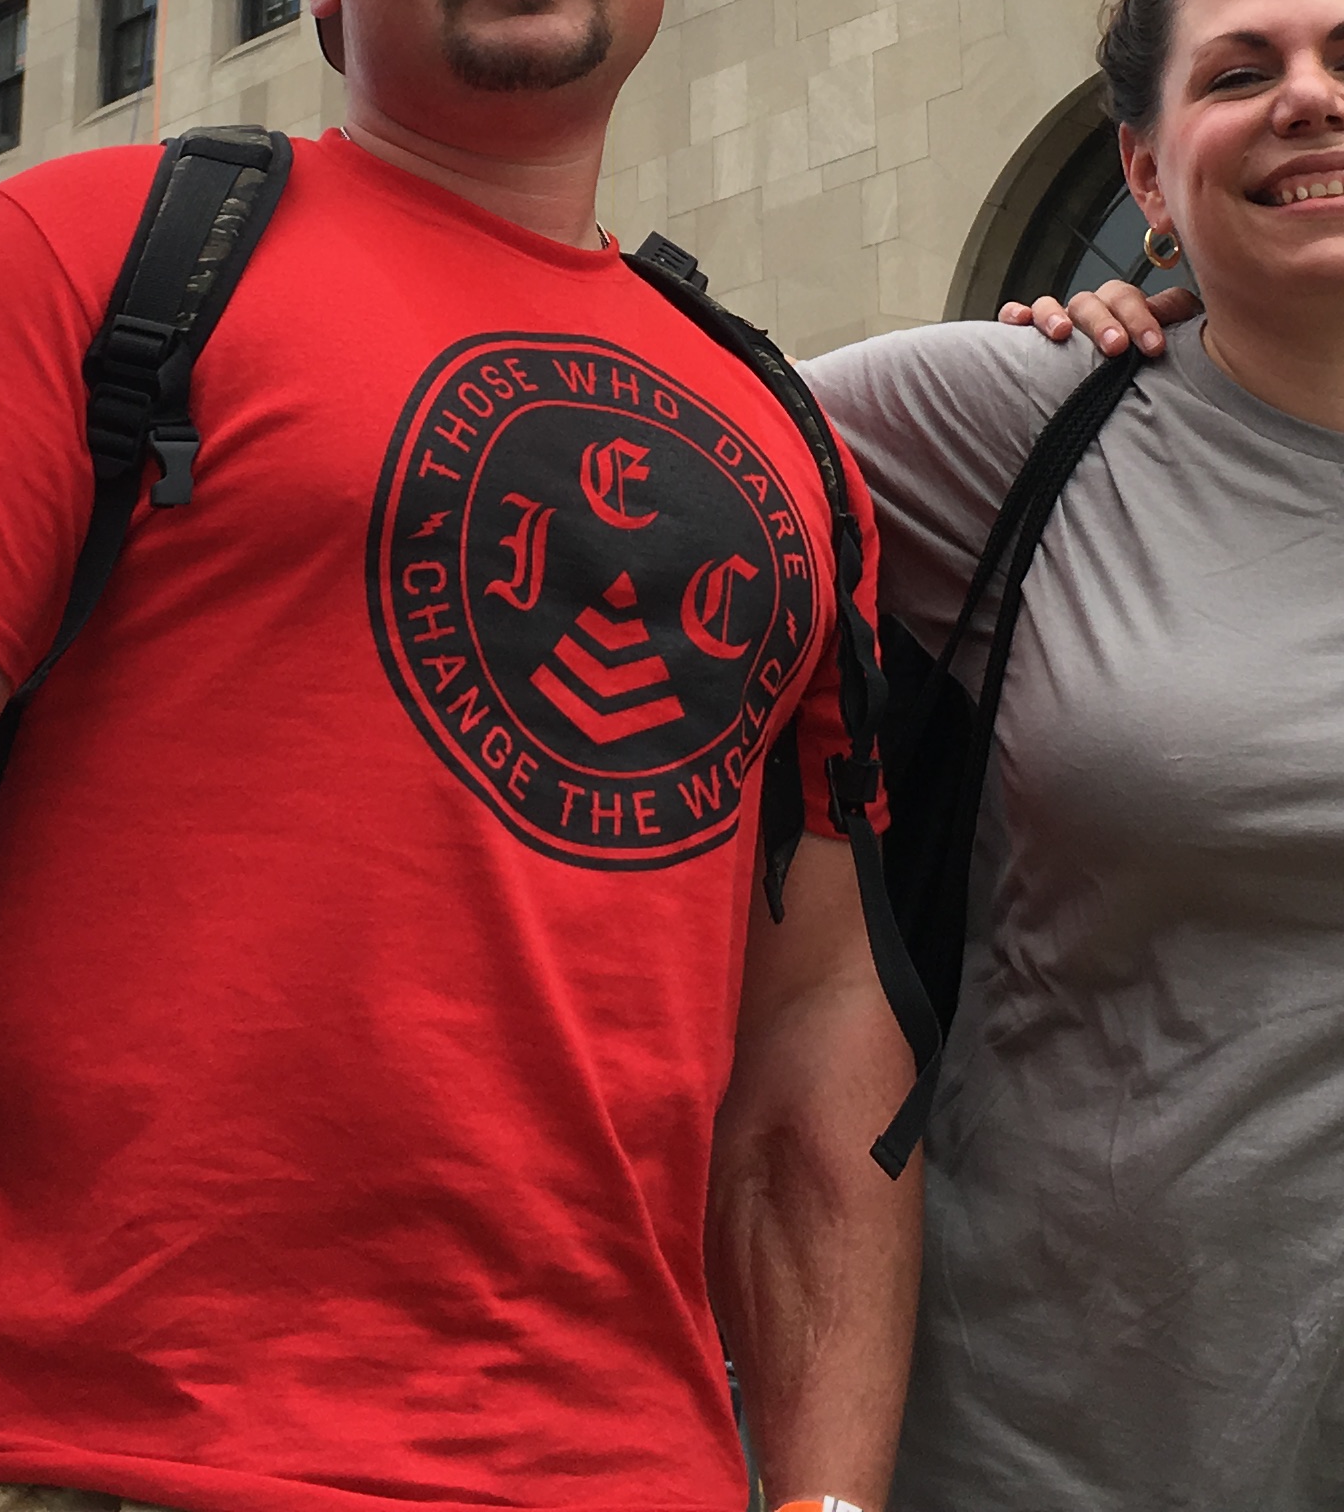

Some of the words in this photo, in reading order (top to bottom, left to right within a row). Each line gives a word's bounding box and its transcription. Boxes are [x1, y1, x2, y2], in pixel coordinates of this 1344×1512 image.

[418, 357, 539, 482] THOSE
[553, 359, 680, 420] WHO
[713, 434, 808, 581] DARE
[402, 559, 539, 801] CHANGE
[558, 780, 662, 837] THE
